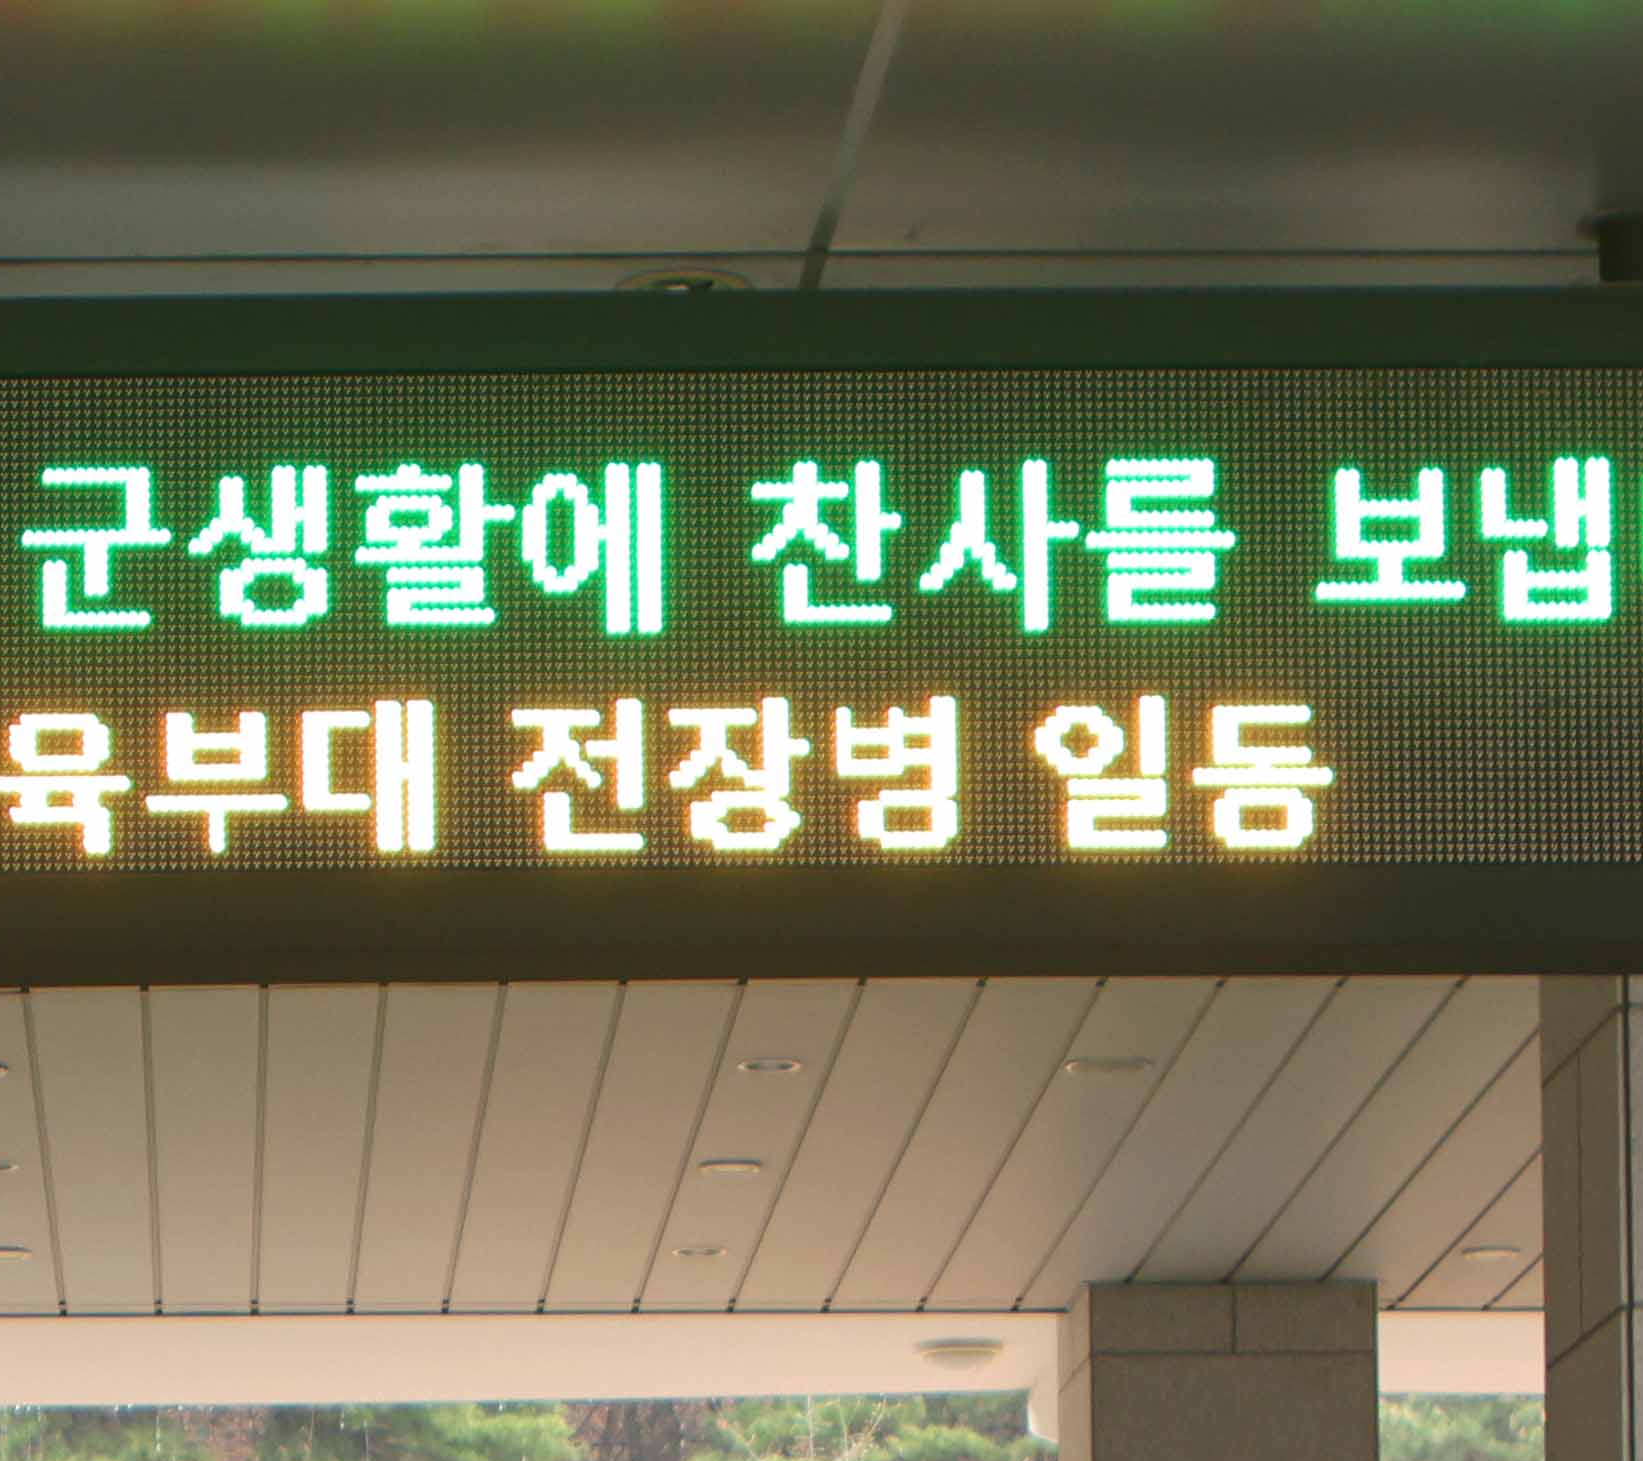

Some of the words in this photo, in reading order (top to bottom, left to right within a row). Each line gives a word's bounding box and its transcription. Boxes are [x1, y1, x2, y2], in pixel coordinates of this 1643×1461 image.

[20, 461, 664, 636] 군생활에
[750, 456, 1237, 633] 찬사를
[510, 696, 959, 852] 전장병
[1030, 694, 1334, 850] 일동
